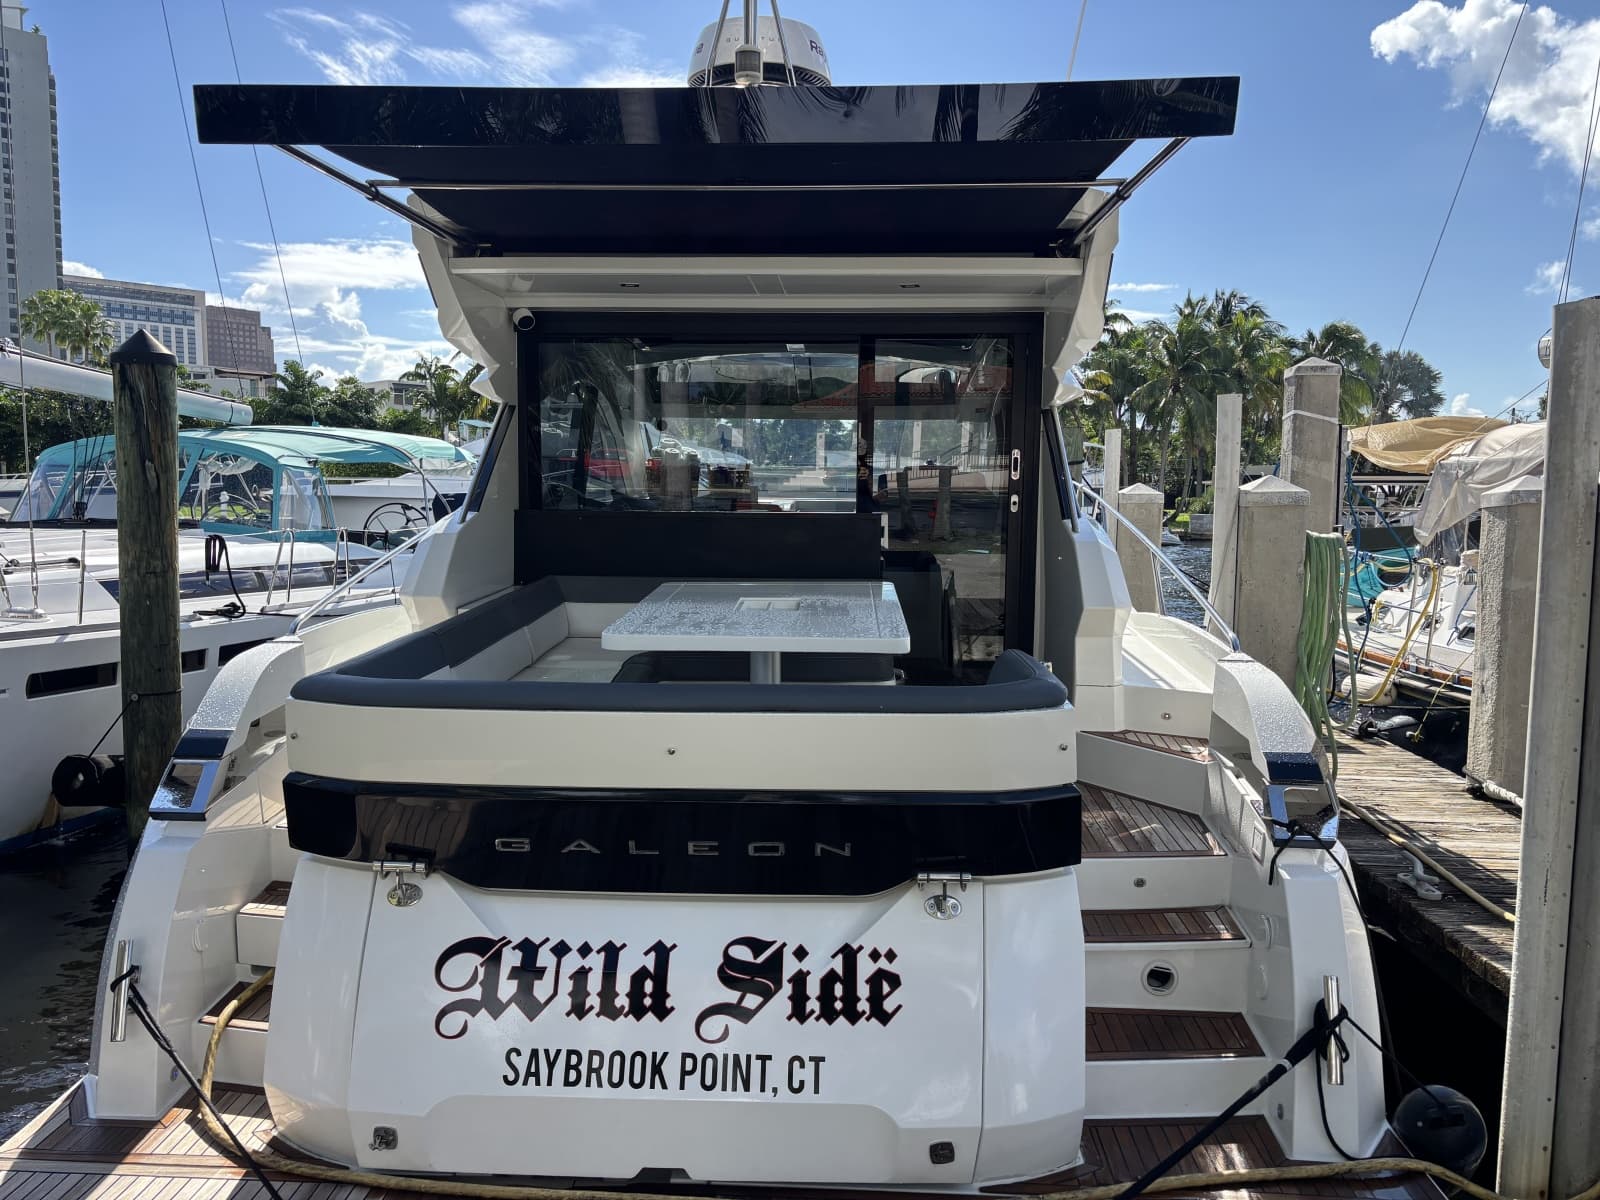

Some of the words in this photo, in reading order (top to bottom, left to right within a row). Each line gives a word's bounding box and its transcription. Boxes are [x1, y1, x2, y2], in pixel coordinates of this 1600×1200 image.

[494, 838, 851, 857] GALEON
[434, 935, 678, 1040] Wild
[694, 936, 903, 1044] Sidë
[502, 1047, 669, 1090] SAYBROOK
[679, 1050, 778, 1098] POINT,
[787, 1055, 826, 1095] CT
